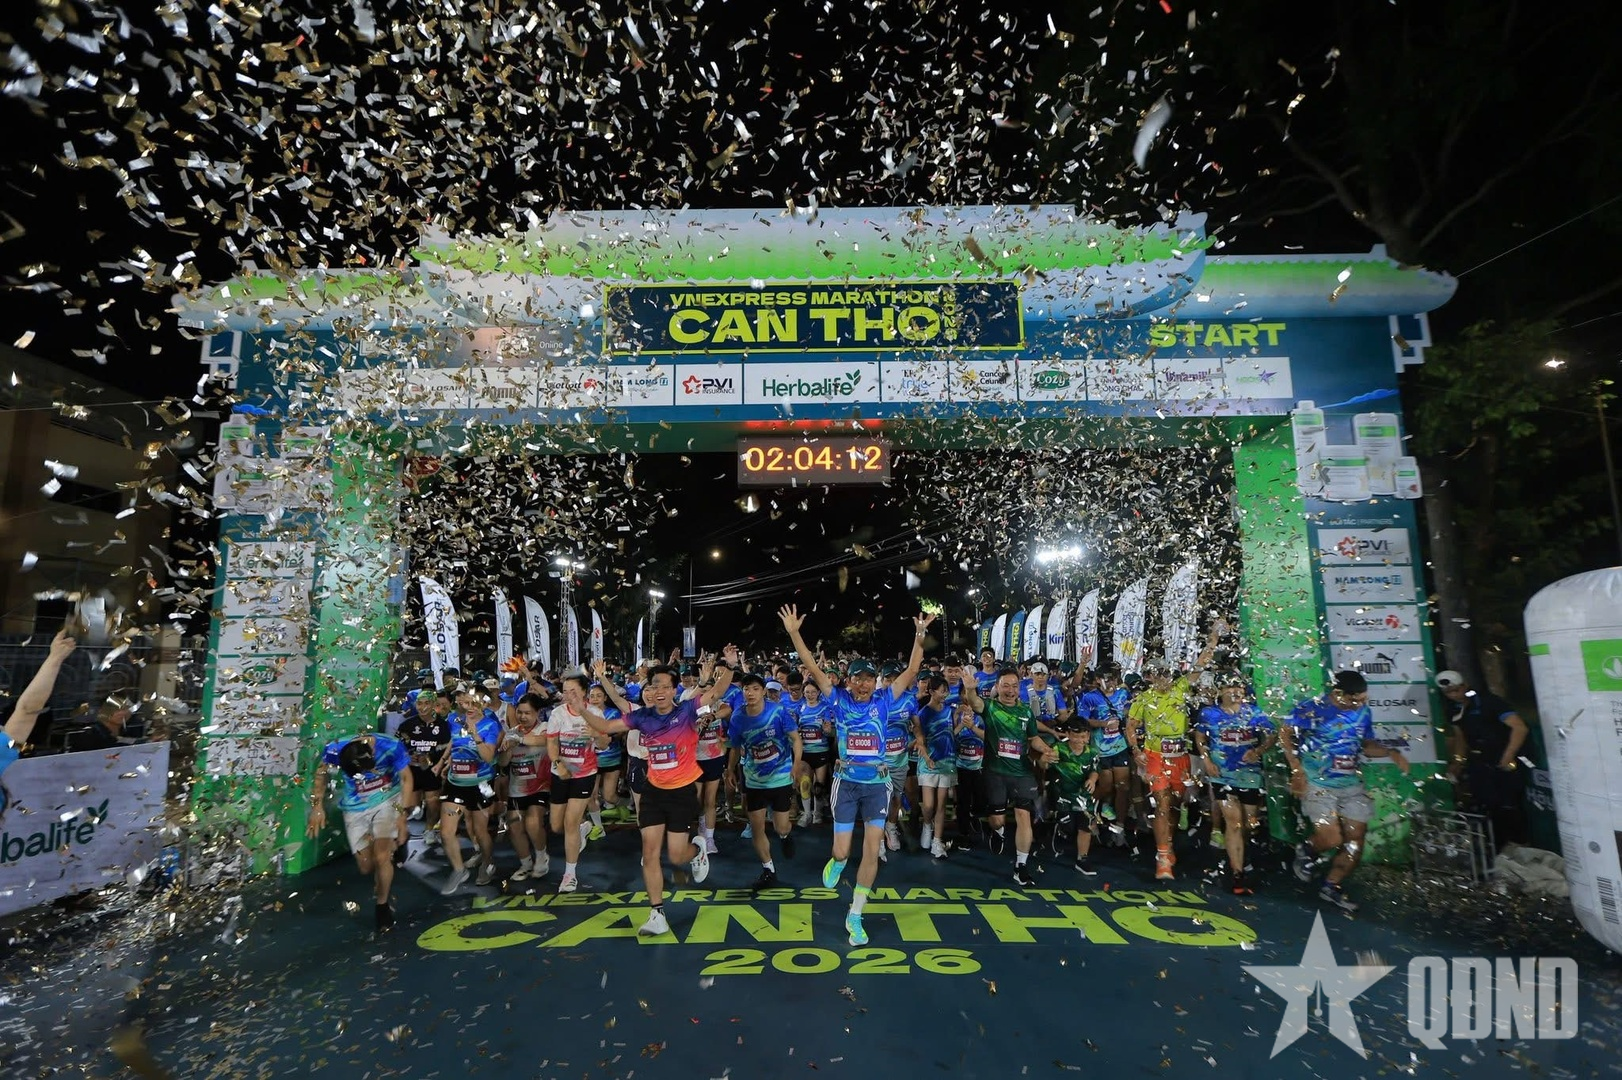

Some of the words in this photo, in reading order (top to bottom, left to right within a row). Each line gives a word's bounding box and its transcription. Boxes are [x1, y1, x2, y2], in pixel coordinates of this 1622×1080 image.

[670, 292, 806, 307] VNEXPRESS
[811, 289, 939, 306] MARATHON
[669, 308, 798, 344] CAN
[810, 305, 940, 342] THO
[1150, 322, 1287, 348] START
[702, 378, 733, 389] PVI
[763, 376, 852, 397] Herbalife
[1037, 373, 1066, 386] Cozy
[744, 445, 883, 472] 02:04:12
[1358, 540, 1389, 550] PVI
[531, 614, 542, 657] LOSAR
[1048, 633, 1065, 645] Kiri
[1369, 699, 1417, 707] ELOSAR
[471, 887, 839, 909] VNEXPRESS
[865, 887, 1208, 904] MARATHON
[416, 903, 814, 952] CAN
[850, 904, 1258, 947] THO
[700, 947, 982, 976] 2026
